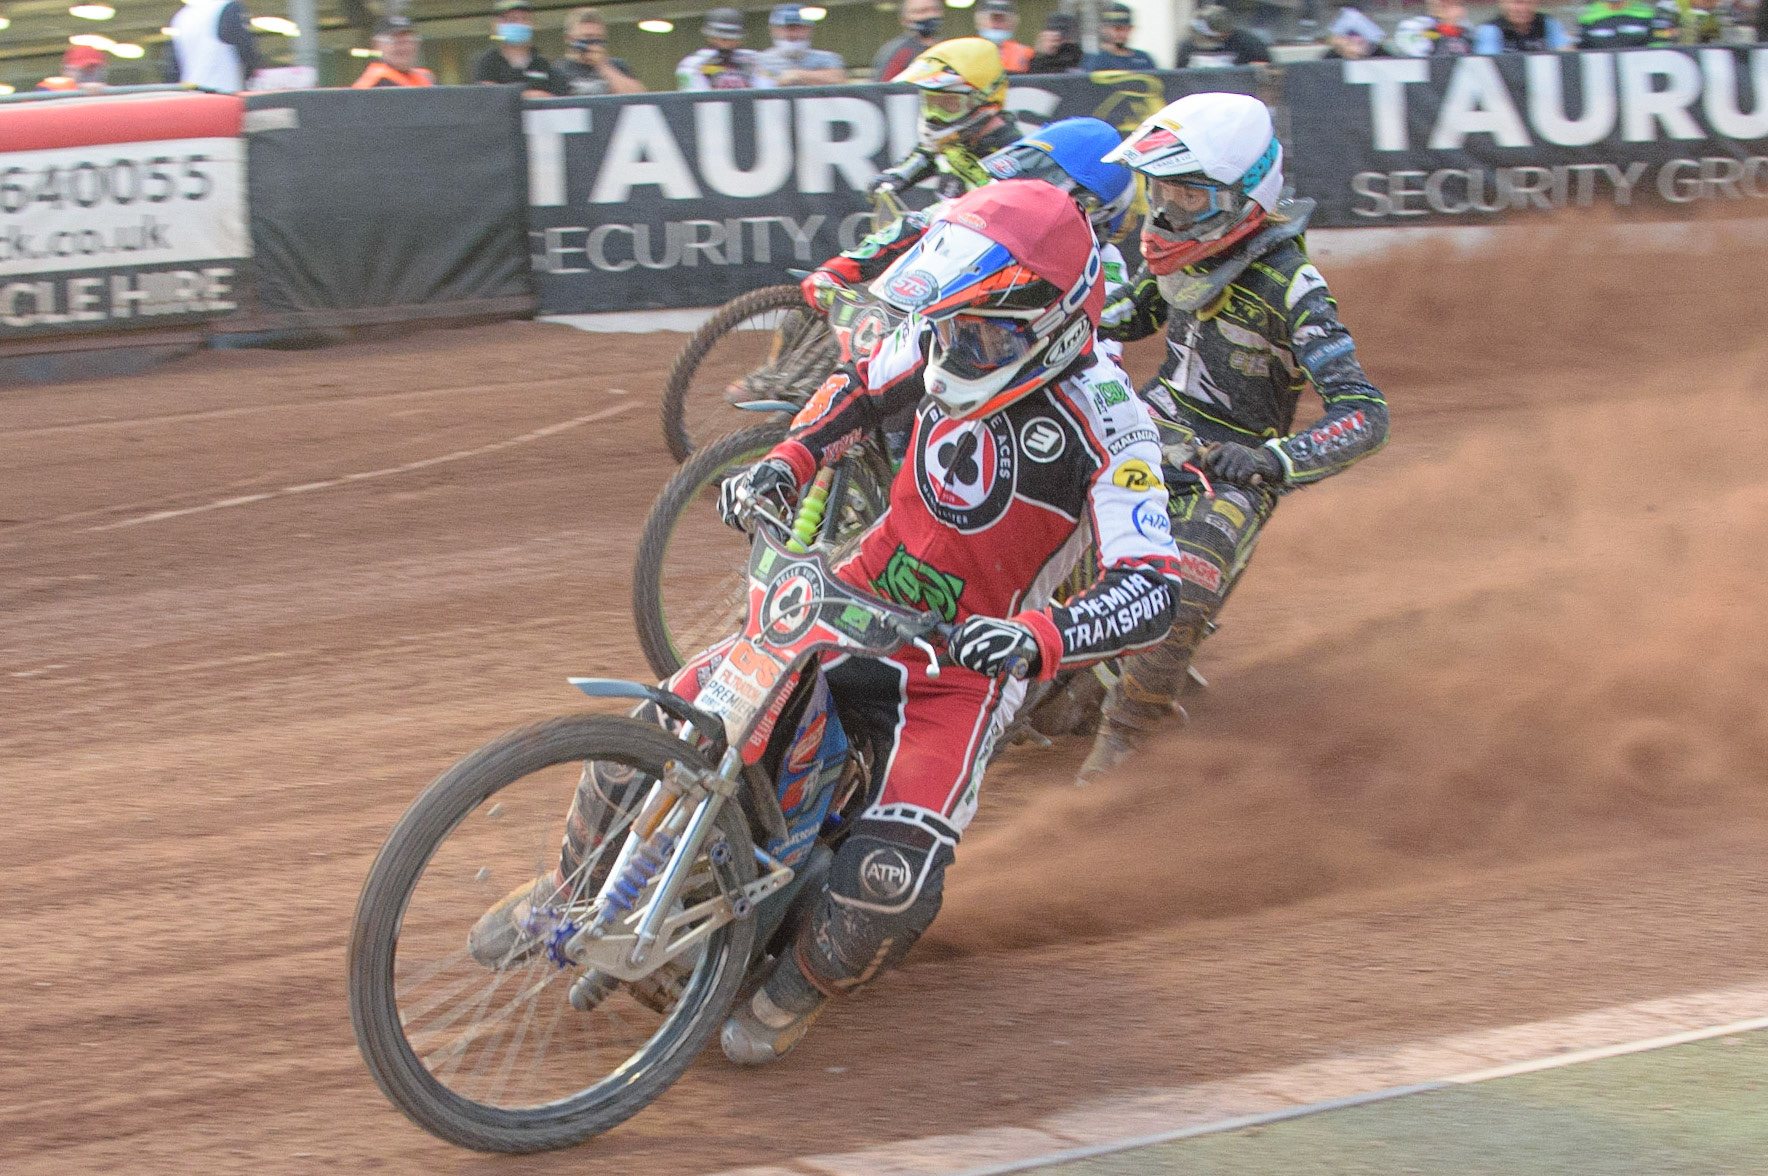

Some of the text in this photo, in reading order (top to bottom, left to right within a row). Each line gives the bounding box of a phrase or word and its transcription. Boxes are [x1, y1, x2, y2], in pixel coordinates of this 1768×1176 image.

[1352, 163, 1650, 217] SECURITY
[109, 267, 238, 320] HIRE
[1032, 244, 1101, 340] SCO
[1064, 583, 1171, 652] TRANSPORT
[708, 679, 758, 718] PREMIER
[866, 864, 904, 882] ATPI
